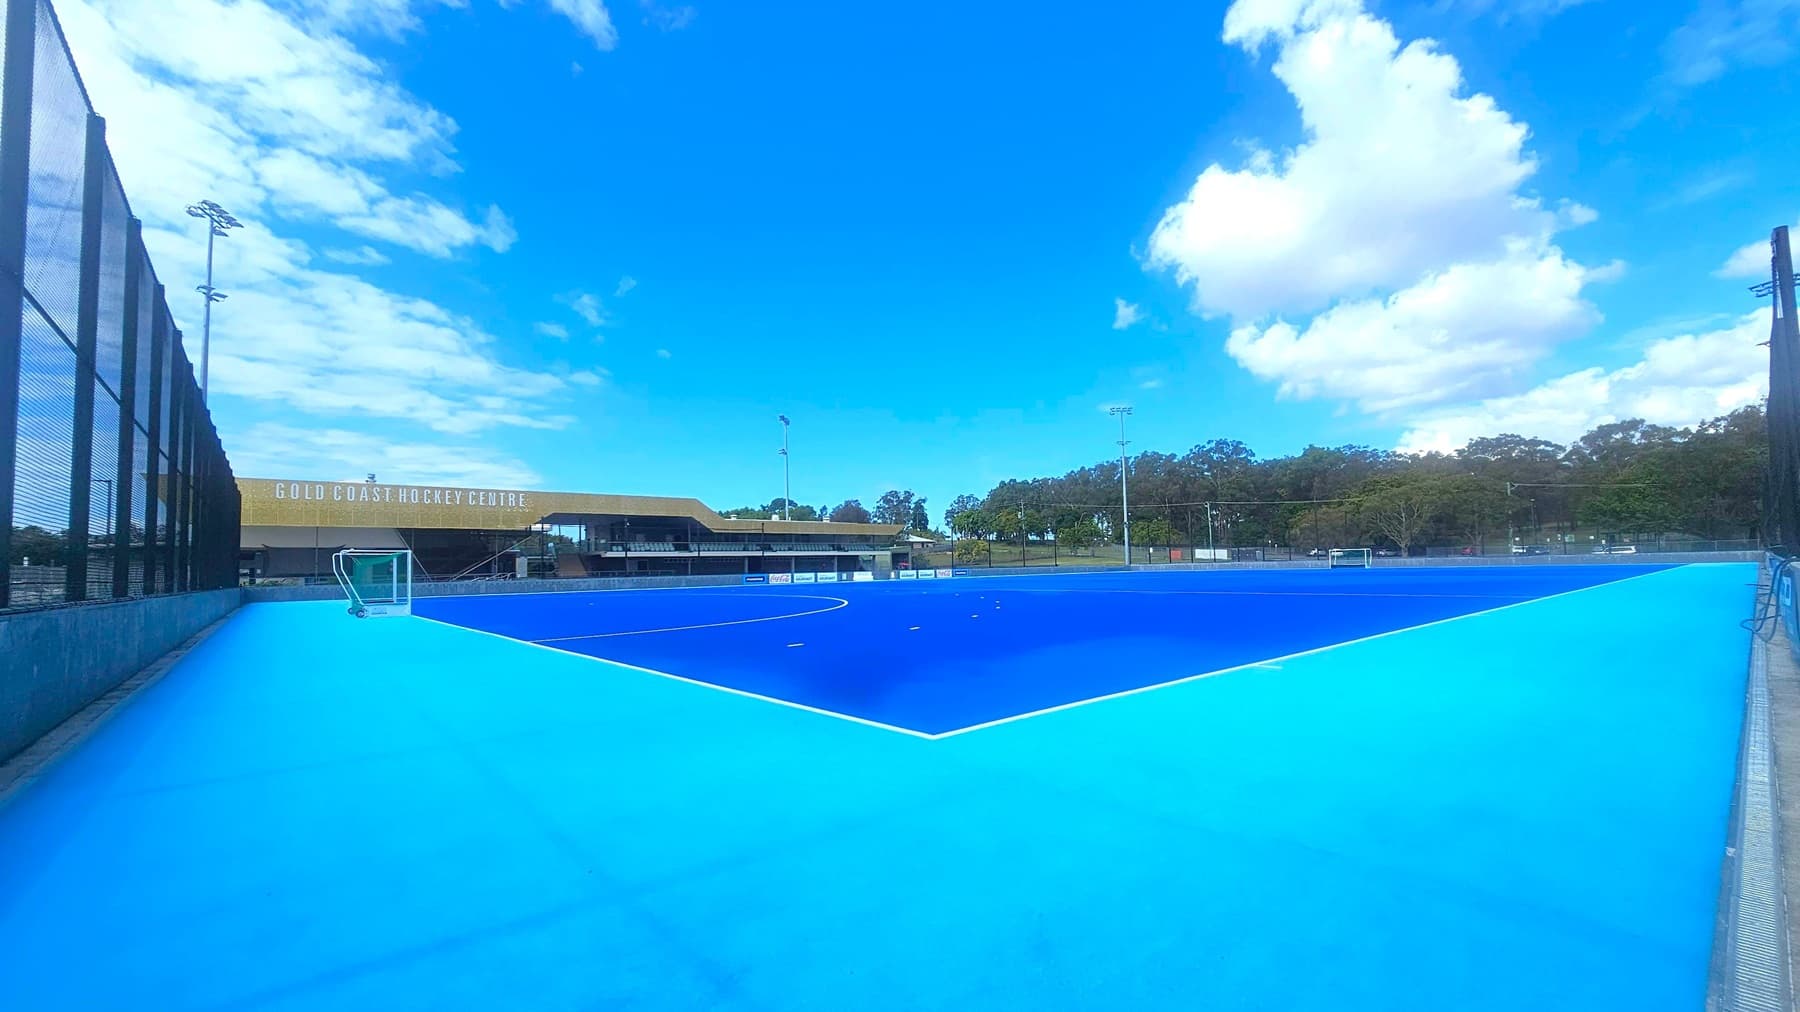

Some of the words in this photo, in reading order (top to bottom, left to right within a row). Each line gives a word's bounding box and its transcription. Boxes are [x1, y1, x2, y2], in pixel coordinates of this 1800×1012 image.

[275, 482, 324, 500] GOLD
[333, 485, 392, 502] COAST
[399, 487, 462, 505] HOCKEY
[468, 490, 526, 507] CENTRE
